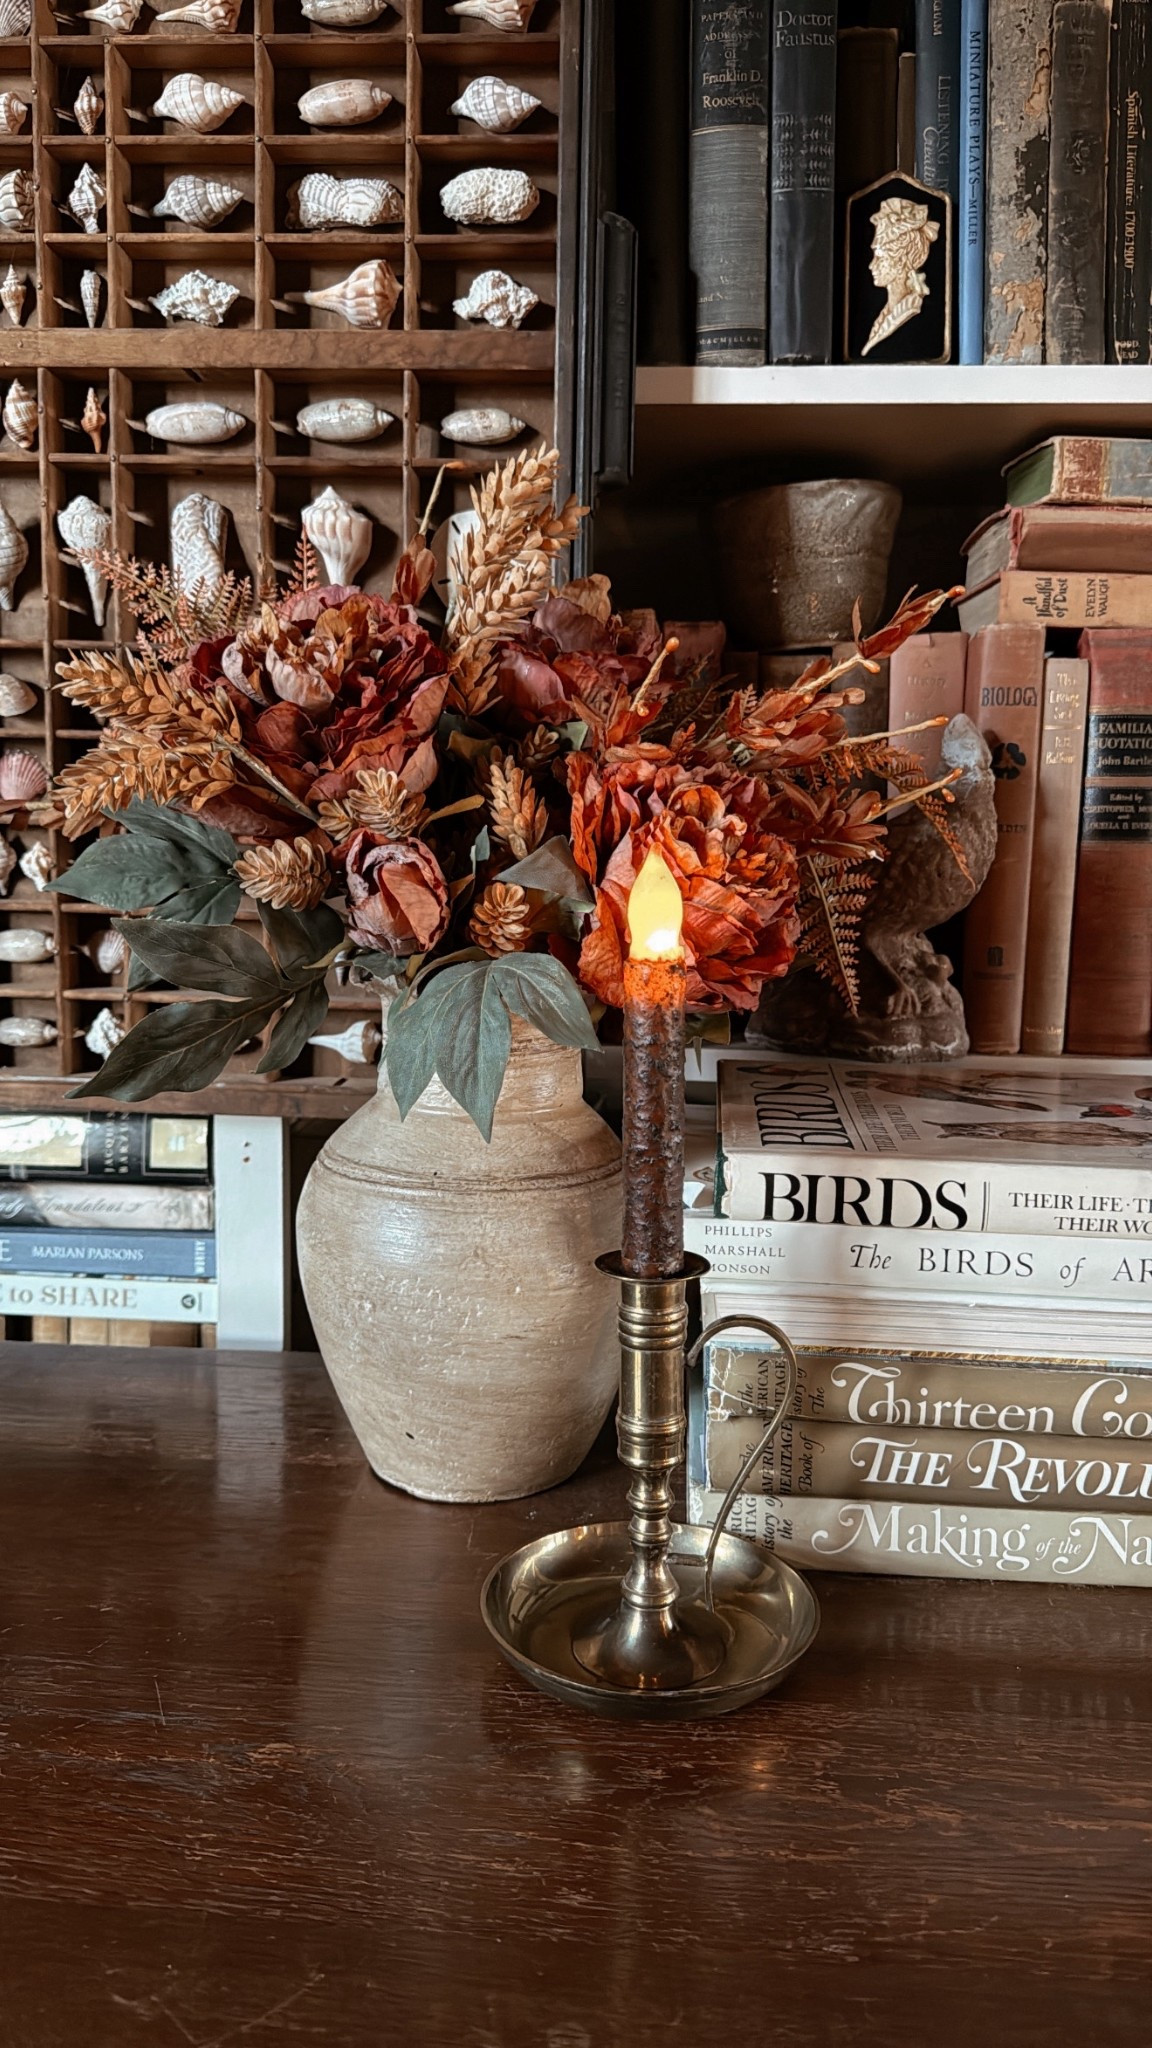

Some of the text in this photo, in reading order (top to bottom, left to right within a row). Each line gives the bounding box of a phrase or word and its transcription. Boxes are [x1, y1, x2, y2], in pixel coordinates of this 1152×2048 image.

[775, 30, 836, 48] Faustus
[777, 10, 834, 28] Doctor
[702, 69, 763, 86] Franklin D.
[968, 31, 982, 127] MINIATURE
[937, 75, 951, 165] LISTENING
[1125, 90, 1138, 139] Spanish
[1123, 210, 1136, 270] 1700-1900
[699, 336, 761, 345] MACMILLAN
[1022, 596, 1037, 605] A
[1035, 577, 1054, 618] Handful
[1051, 578, 1069, 618] of Dust
[1085, 578, 1096, 618] EVELYN
[1097, 578, 1110, 618] WAUGH
[1095, 756, 1121, 768] John
[751, 1081, 854, 1150] BIRDS
[758, 1171, 968, 1231] BIRDS
[1008, 1192, 1074, 1210] THEIR
[704, 1225, 773, 1238] PHILLIPS
[1054, 1216, 1119, 1234] THEIR
[32, 1245, 85, 1259] MARIAN
[86, 1248, 145, 1262] PARSONS
[704, 1244, 786, 1258] MARSHALL
[850, 1243, 892, 1271] The
[918, 1247, 1034, 1278] BIRDS
[1059, 1256, 1087, 1288] of
[10, 1288, 33, 1303] to
[40, 1285, 138, 1309] SHARE
[808, 1387, 825, 1414] The
[831, 1362, 1055, 1434] Thirteen
[798, 1431, 825, 1493] Book of
[850, 1437, 954, 1487] THE
[777, 1518, 794, 1540] the
[811, 1505, 1031, 1572] Making
[1035, 1537, 1056, 1561] of
[1057, 1536, 1082, 1555] the
